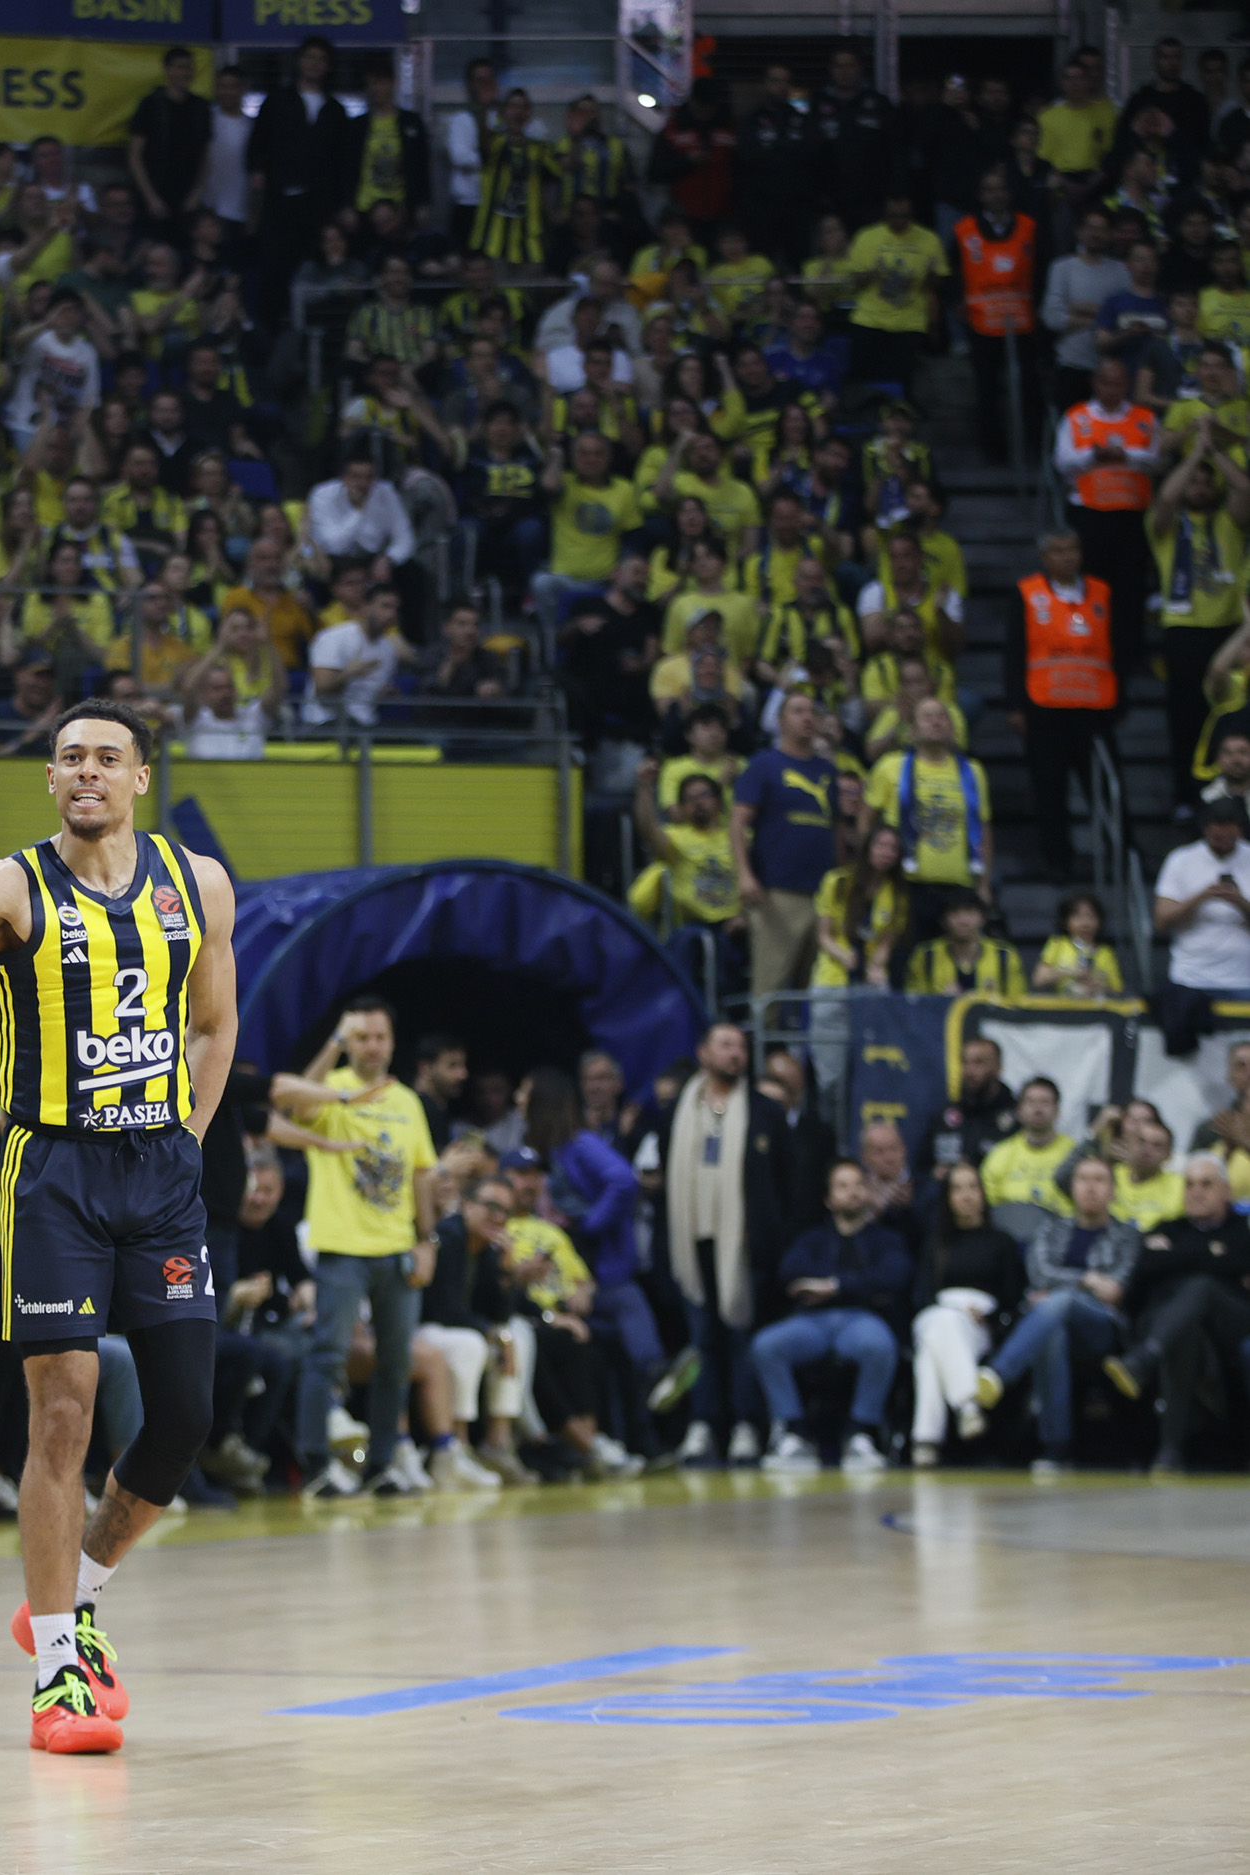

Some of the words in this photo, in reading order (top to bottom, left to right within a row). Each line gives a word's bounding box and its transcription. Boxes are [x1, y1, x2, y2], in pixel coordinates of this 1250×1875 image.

[70, 0, 183, 24] BASIN
[254, 0, 374, 26] PRESS
[61, 929, 88, 939] beko
[163, 930, 193, 940] oneteam
[113, 968, 148, 1018] 2
[76, 1027, 174, 1067] beko
[103, 1103, 171, 1126] PASHA
